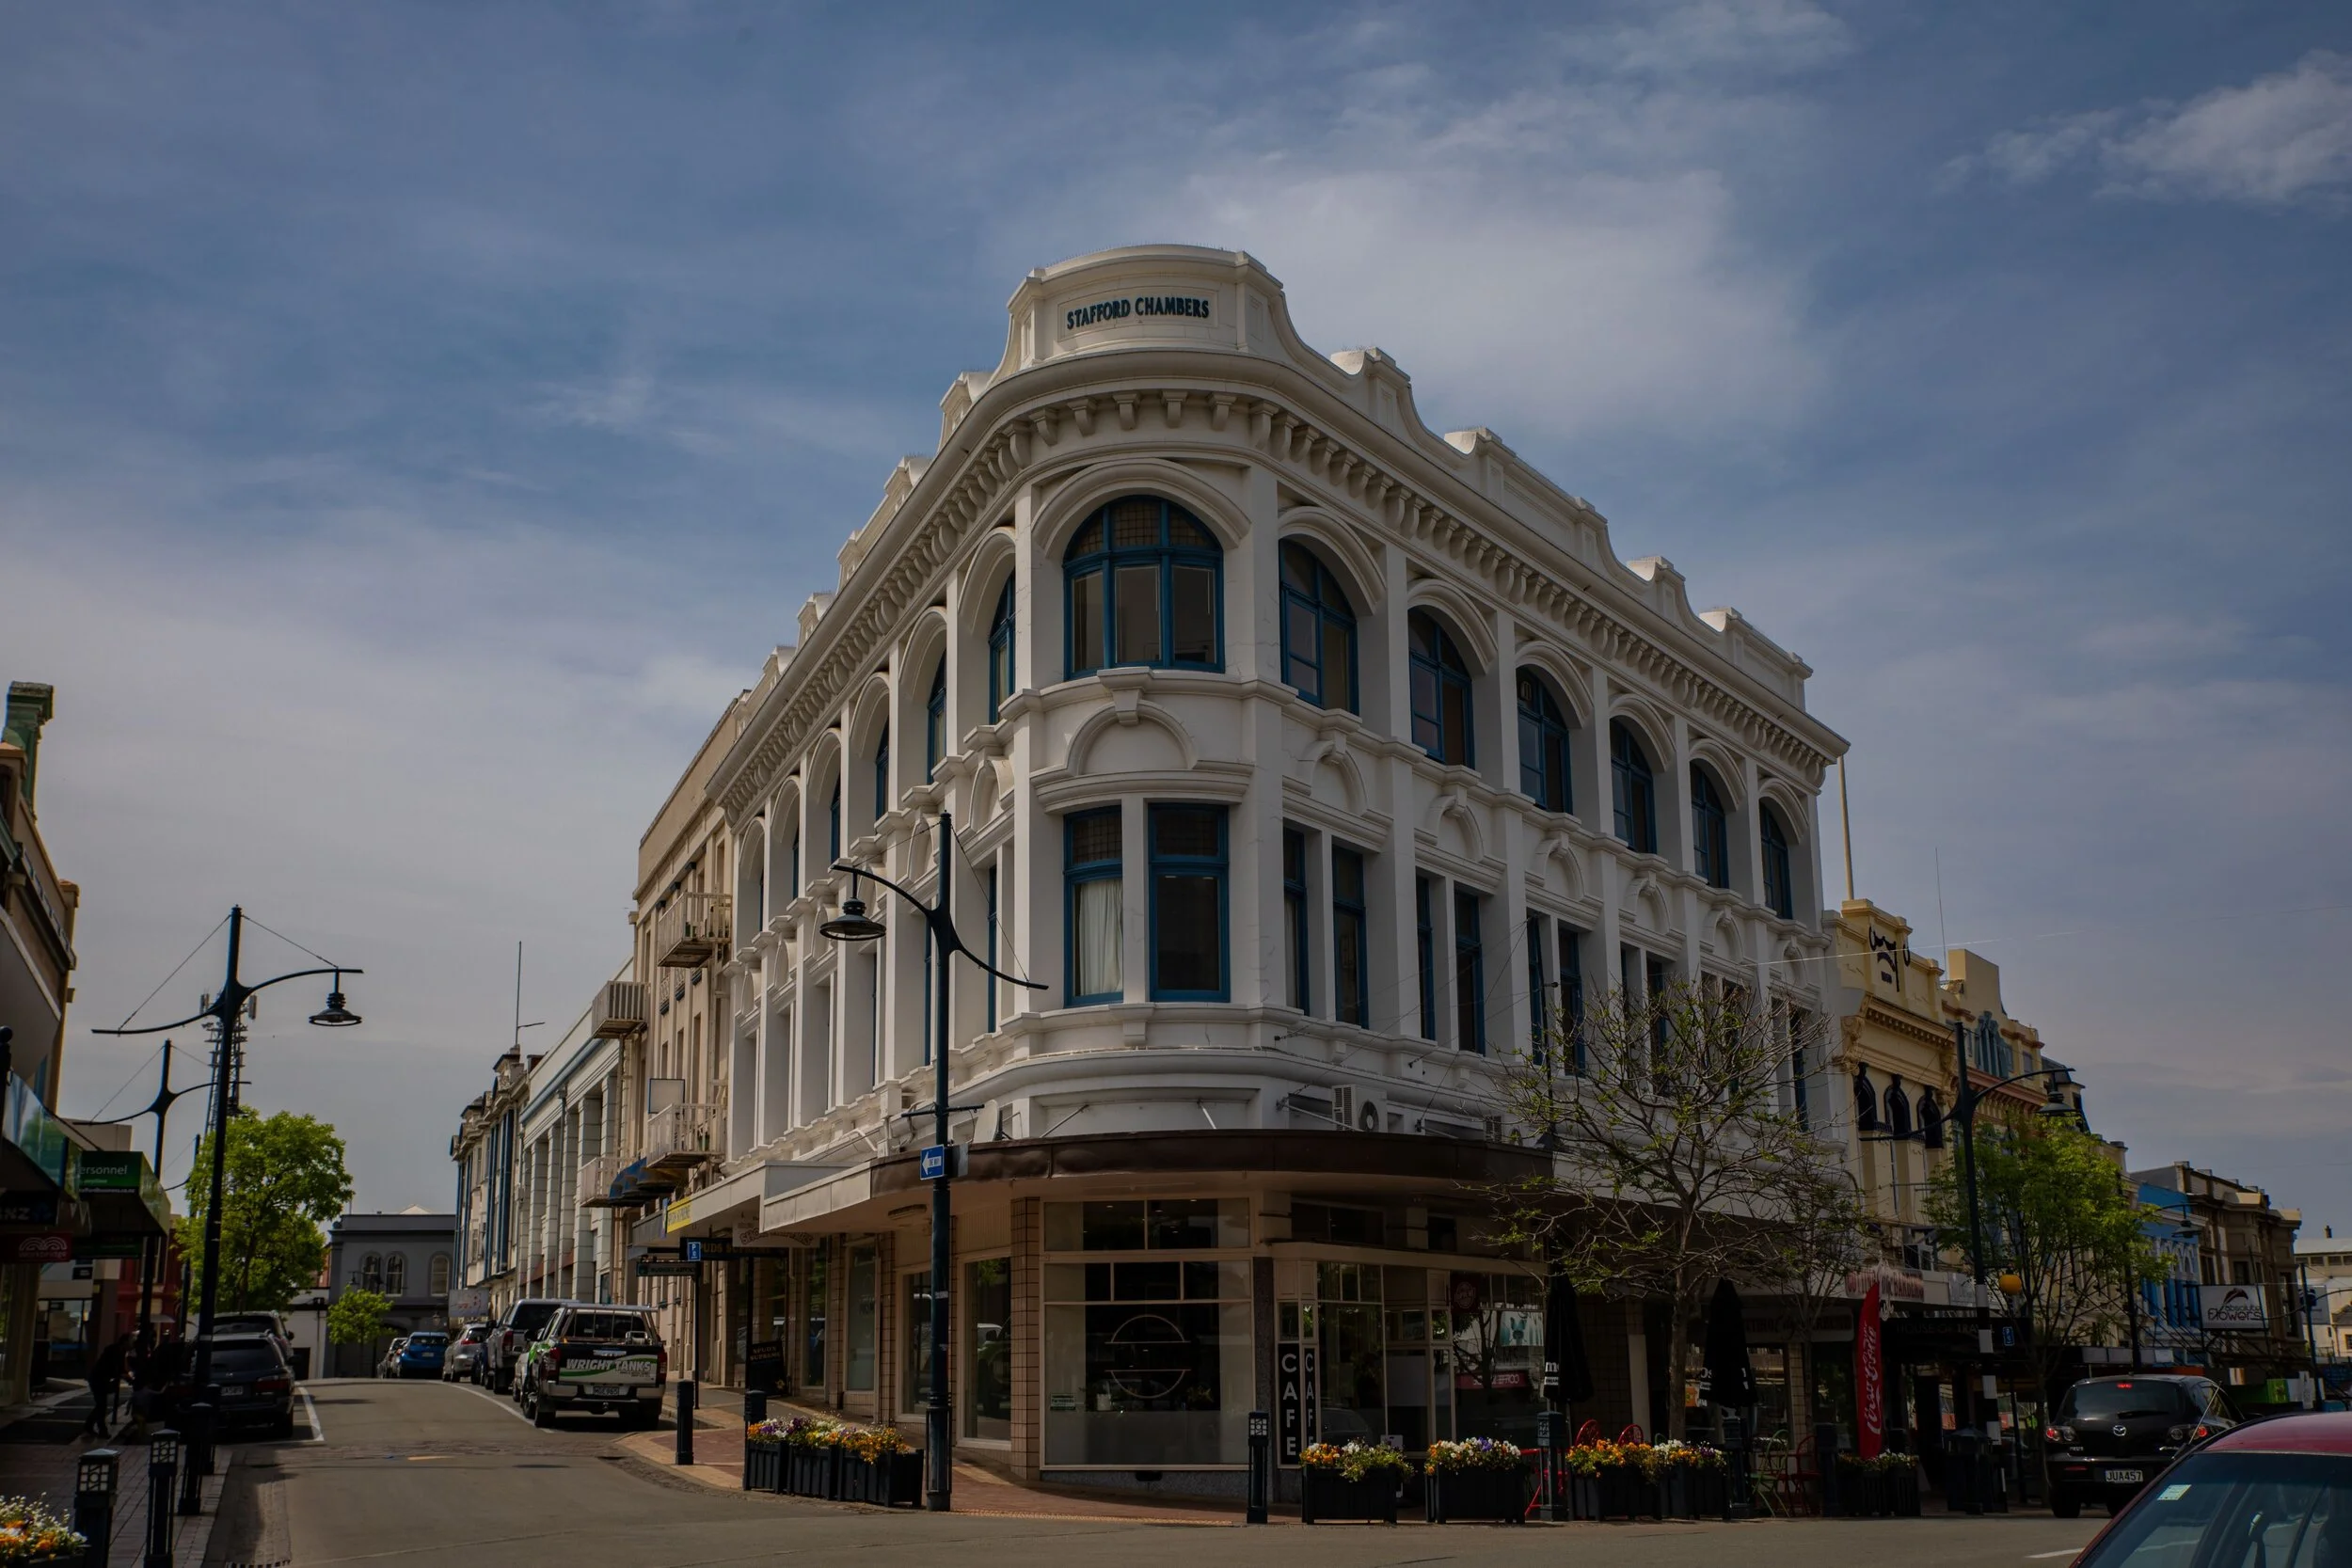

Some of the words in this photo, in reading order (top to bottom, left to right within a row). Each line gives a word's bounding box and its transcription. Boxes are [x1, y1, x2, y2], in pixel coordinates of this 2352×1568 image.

[1067, 299, 1131, 329] STAFFORD
[1135, 297, 1209, 318] CHAMBERS
[0, 1207, 31, 1221] NZ
[565, 1358, 613, 1370] WRIGHT
[614, 1360, 652, 1372] TANKS
[1281, 1353, 1298, 1456] CAFE
[2106, 1469, 2142, 1482] JUA457
